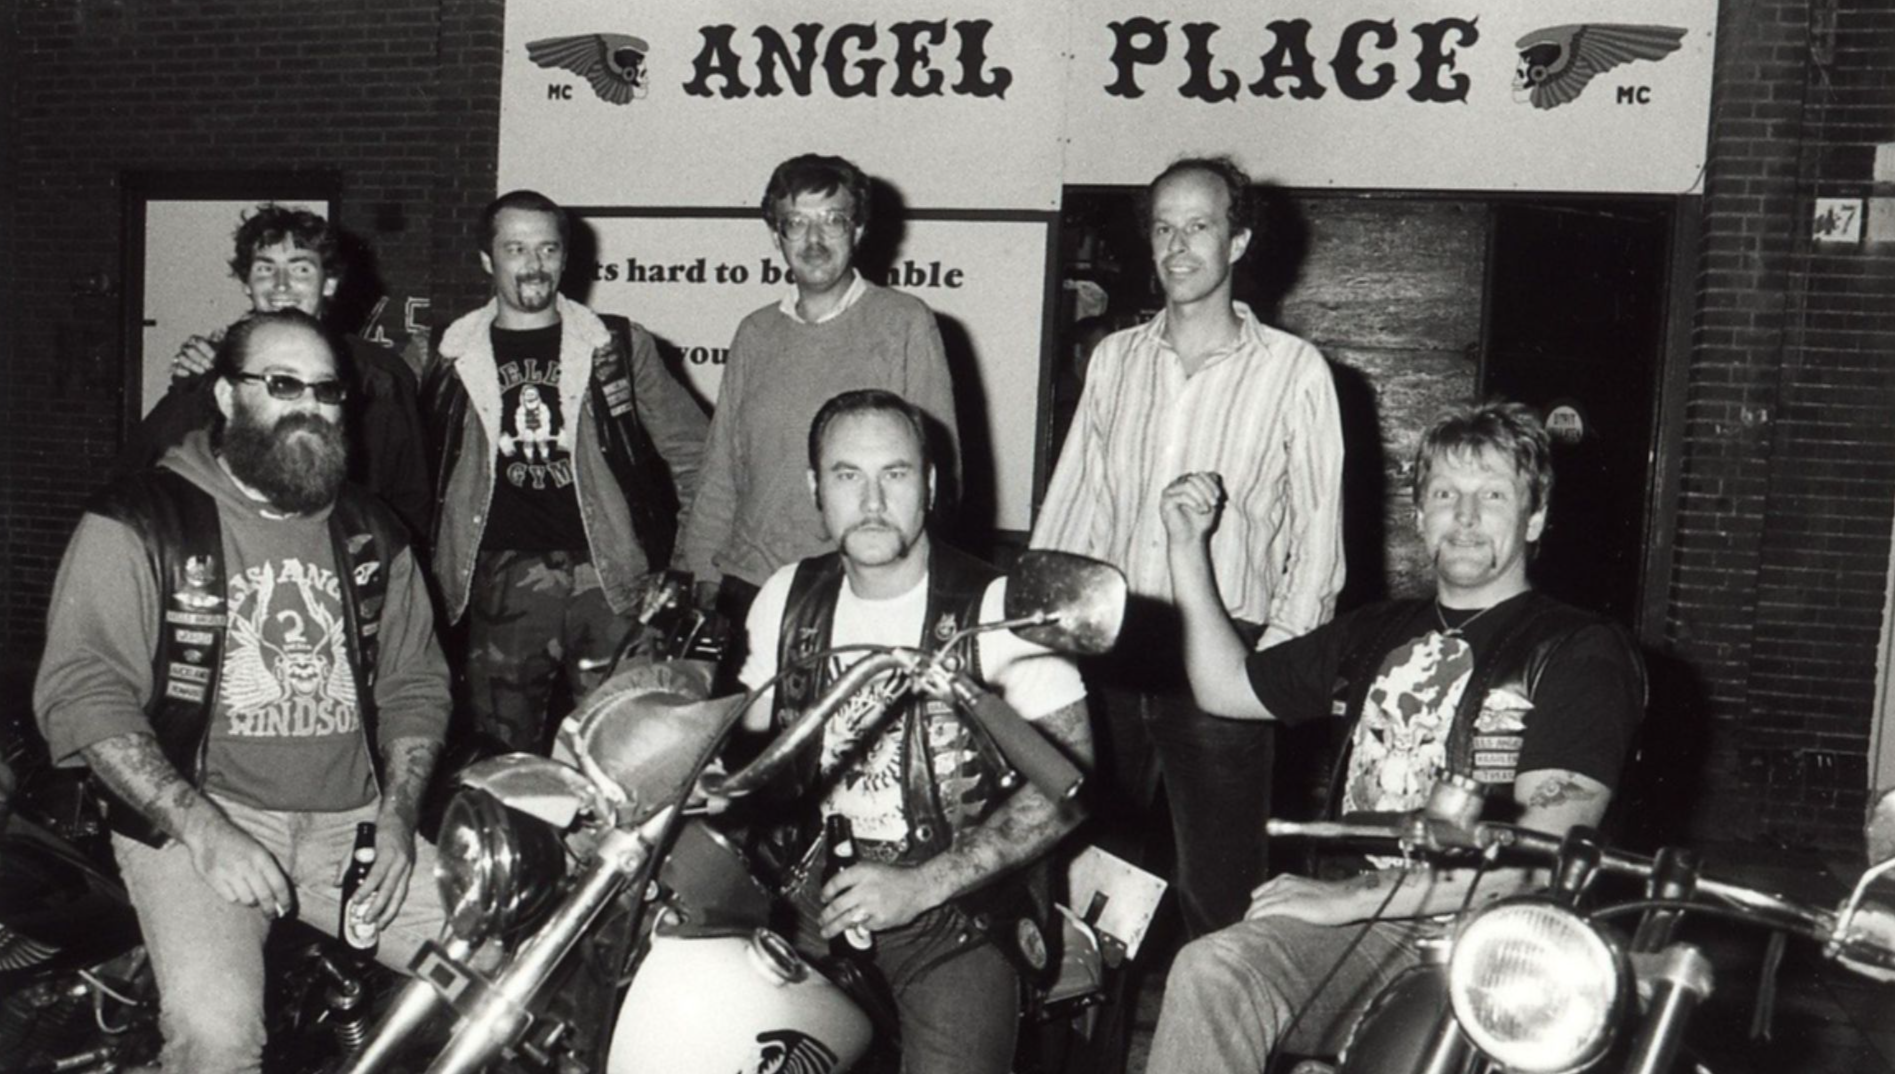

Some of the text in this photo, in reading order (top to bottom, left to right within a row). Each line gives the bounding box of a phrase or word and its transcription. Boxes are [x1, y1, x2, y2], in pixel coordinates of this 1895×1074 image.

[682, 16, 1480, 104] ANGEL PLACE
[547, 83, 573, 101] MC
[1616, 85, 1651, 105] MC
[626, 257, 707, 284] hard
[715, 262, 749, 285] to
[500, 358, 560, 394] ELL
[506, 459, 573, 489] GYM
